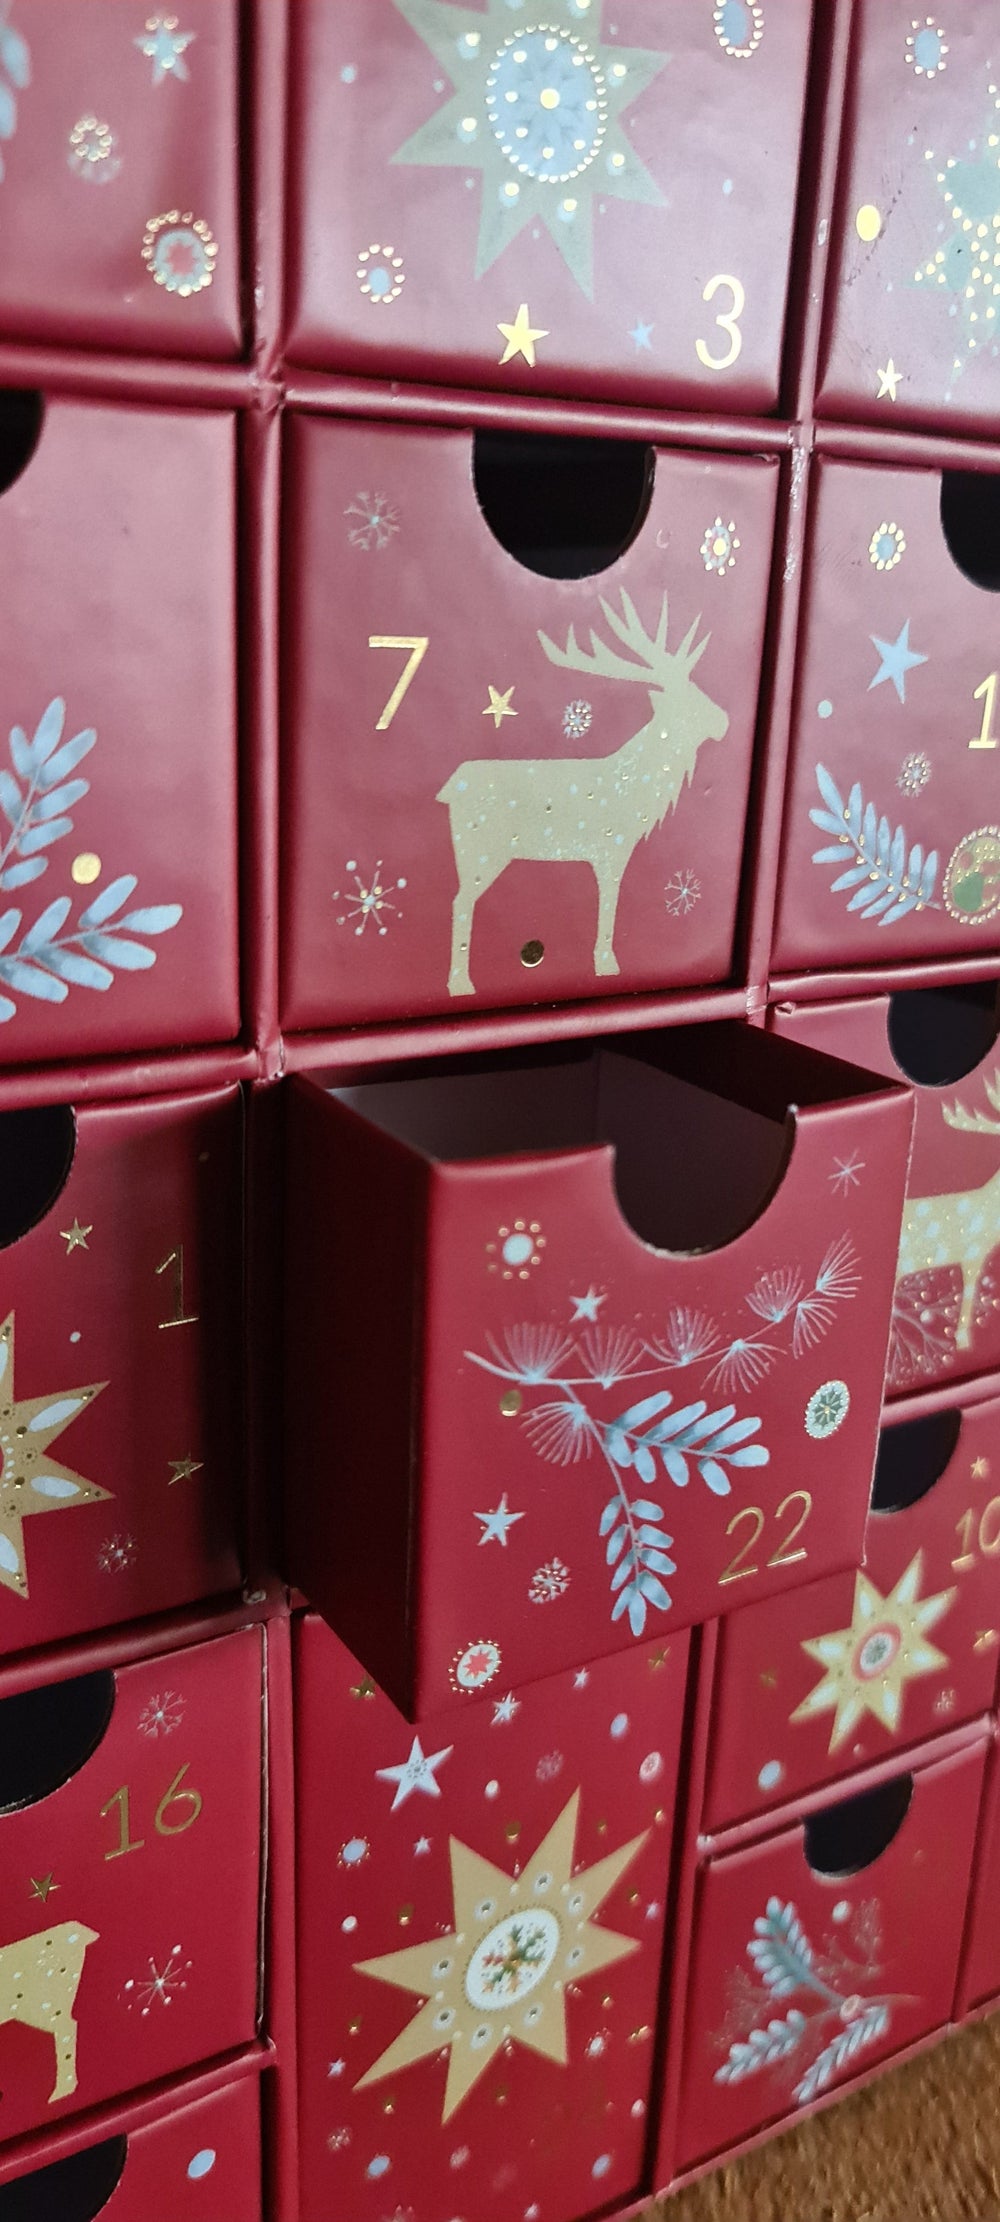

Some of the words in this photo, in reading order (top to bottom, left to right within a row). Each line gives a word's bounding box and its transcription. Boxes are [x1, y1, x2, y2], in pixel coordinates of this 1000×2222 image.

[695, 274, 745, 370] 3
[368, 634, 429, 731] 7
[155, 1243, 199, 1329] 1
[717, 1489, 813, 1586] 22
[100, 1761, 203, 1861] 16
